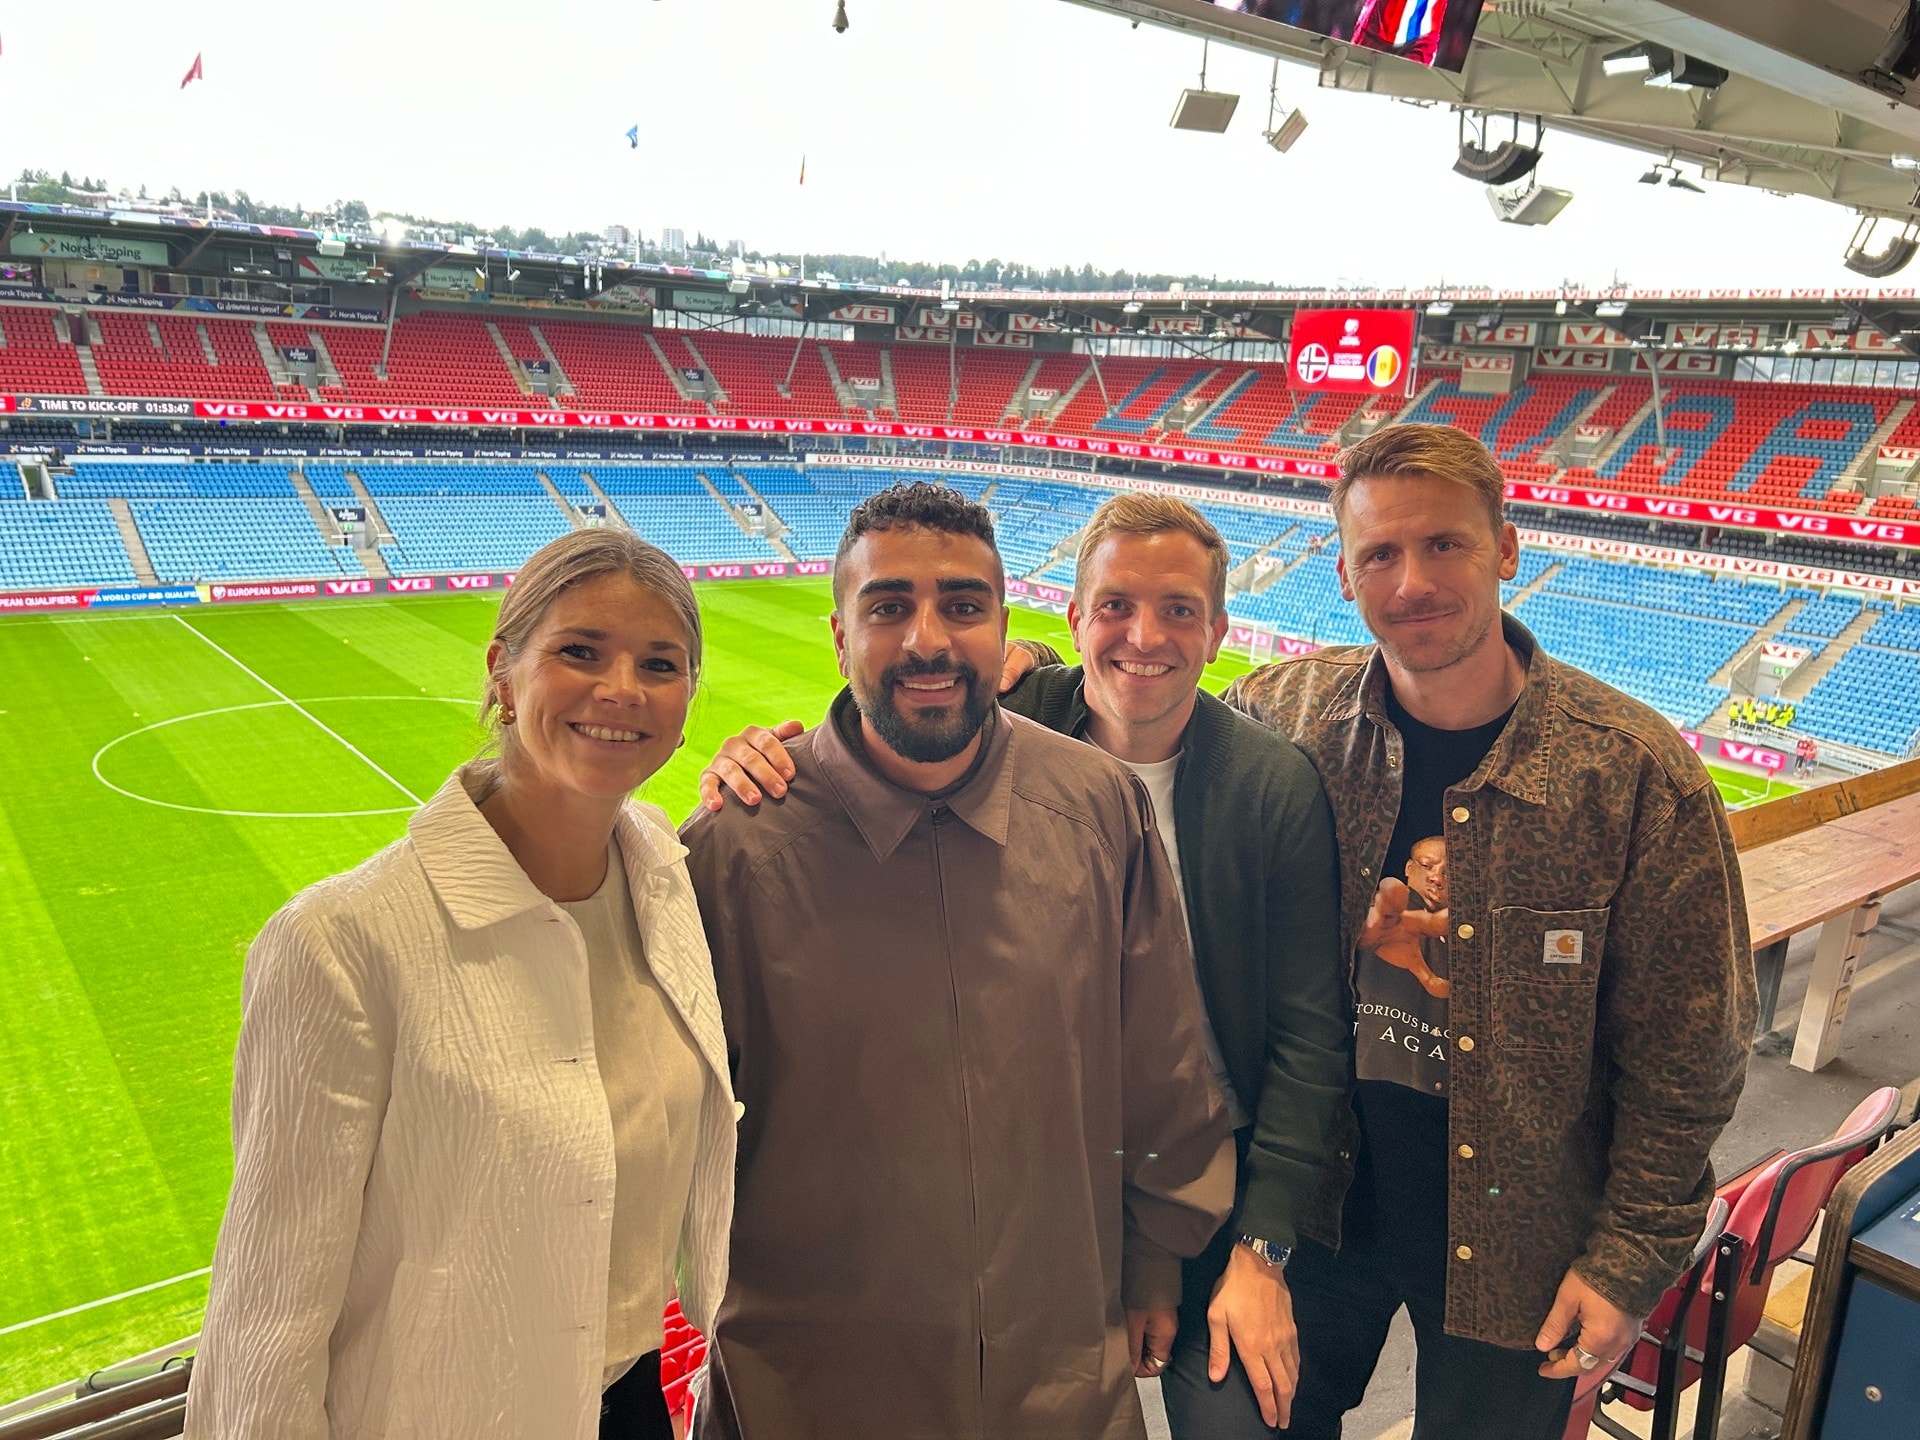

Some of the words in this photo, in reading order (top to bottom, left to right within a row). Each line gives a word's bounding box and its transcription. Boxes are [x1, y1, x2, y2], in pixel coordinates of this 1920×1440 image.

[61, 242, 94, 254] Norsk
[98, 244, 140, 260] Tipping
[16, 290, 42, 300] Tipping
[118, 296, 136, 305] Norsk
[138, 298, 163, 307] Tipping
[1633, 290, 1661, 300] VG
[1670, 290, 1700, 299] VG
[1709, 290, 1739, 300] VG
[1749, 289, 1780, 299] VG
[1790, 289, 1824, 299] VG
[1834, 289, 1868, 299] VG
[1879, 289, 1914, 299] VG
[356, 312, 378, 322] Tipping
[838, 307, 886, 322] VG
[902, 328, 950, 342] VG
[978, 333, 1028, 346] VG
[1466, 325, 1525, 343] VG
[1464, 358, 1510, 370] VG
[1541, 350, 1604, 367] VG
[1639, 352, 1714, 371] VG
[854, 378, 878, 386] VG
[1032, 389, 1055, 397] VG
[39, 400, 68, 410] TIME
[70, 400, 86, 410] TO
[88, 401, 139, 412] KICK-OFF
[146, 403, 190, 414] 01:53:47
[203, 403, 247, 415] VG
[265, 405, 306, 417] VG
[323, 407, 363, 418] VG
[378, 409, 416, 420] VG
[432, 410, 467, 421] VG
[482, 411, 517, 422] VG
[531, 413, 564, 423] VG
[577, 414, 610, 424] VG
[623, 415, 653, 426] VG
[666, 417, 694, 427] VG
[707, 418, 735, 428] VG
[747, 419, 774, 430] VG
[785, 420, 811, 431] VG
[824, 422, 851, 432] VG
[863, 423, 891, 433] VG
[902, 426, 932, 436] VG
[944, 428, 972, 438] VG
[984, 431, 1011, 441] VG
[1021, 433, 1046, 444] VG
[1055, 437, 1079, 448] VG
[1086, 440, 1108, 451] VG
[1117, 443, 1140, 455] VG
[1149, 446, 1173, 458] VG
[1183, 449, 1208, 462] VG
[1218, 453, 1245, 466] VG
[1256, 457, 1283, 471] VG
[1296, 461, 1325, 475] VG
[105, 446, 127, 454] Tipping
[170, 447, 190, 455] Tipping
[230, 448, 250, 456] Tipping
[344, 449, 361, 457] Tipping
[1880, 448, 1920, 460] VG
[817, 455, 841, 463] VG
[846, 456, 872, 464] VG
[877, 457, 902, 465] VG
[940, 460, 965, 469] VG
[971, 462, 996, 472] VG
[1001, 465, 1024, 474] VG
[1029, 467, 1052, 477] VG
[1056, 470, 1077, 480] VG
[1081, 473, 1100, 483] VG
[1104, 476, 1124, 486] VG
[1128, 478, 1149, 490] VG
[1153, 482, 1175, 497] VG
[1179, 485, 1201, 497] VG
[1206, 489, 1229, 501] VG
[1234, 492, 1258, 505] VG
[1263, 496, 1288, 509] VG
[1293, 500, 1319, 513] VG
[1530, 486, 1569, 502] VG
[1585, 492, 1626, 509] VG
[1644, 499, 1689, 516] VG
[1708, 506, 1755, 523] VG
[1776, 513, 1828, 531] VG
[1849, 521, 1904, 540] VG
[1548, 534, 1582, 548] VG
[1591, 540, 1626, 554] VG
[1636, 547, 1674, 561] VG
[1684, 553, 1724, 568] VG
[1734, 560, 1776, 575] VG
[1787, 566, 1832, 583] VG
[1844, 574, 1890, 590] VG
[709, 567, 740, 577] VG
[753, 566, 784, 576] VG
[795, 563, 827, 573] VG
[227, 586, 270, 597] EUROPEAN
[272, 585, 316, 595] QUALIFIERS
[327, 582, 370, 594] VG
[390, 579, 432, 590] VG
[450, 576, 489, 588] VG
[1005, 581, 1028, 594] VG
[1036, 587, 1062, 601] VG
[25, 596, 78, 606] QUALIFIERS
[102, 594, 130, 602] WORLD
[132, 592, 147, 600] CUP
[1235, 628, 1268, 646] VG
[1763, 644, 1803, 659] VG
[1724, 742, 1780, 768] VG
[1356, 1004, 1418, 1028] TORIOUS
